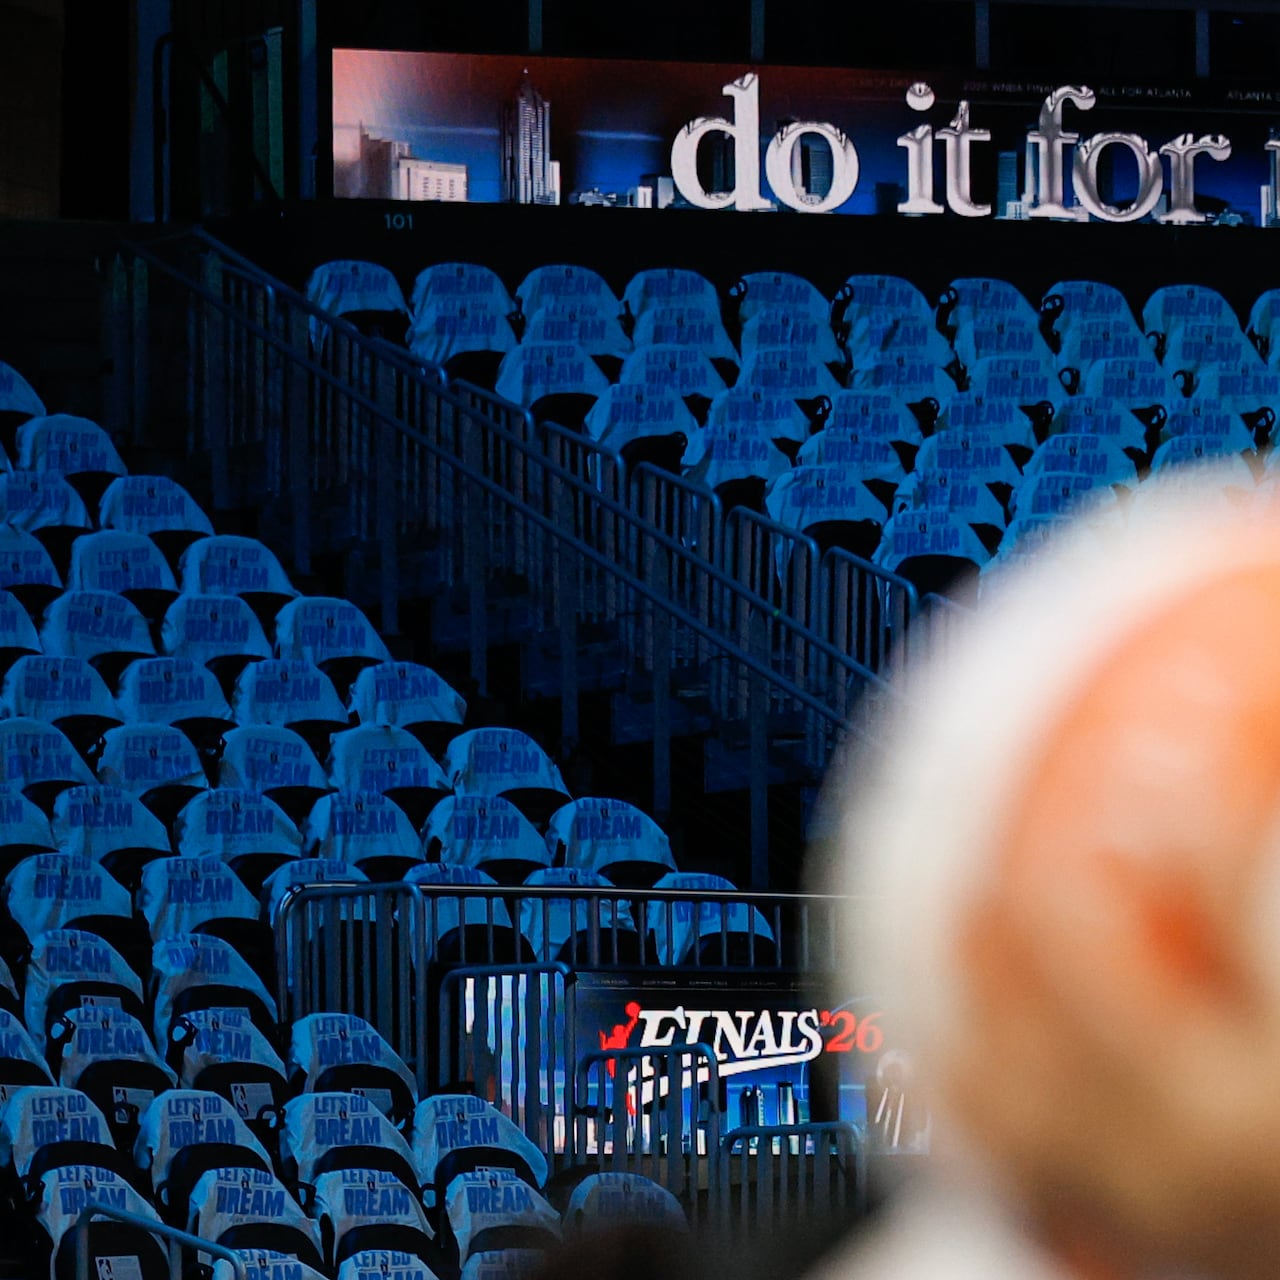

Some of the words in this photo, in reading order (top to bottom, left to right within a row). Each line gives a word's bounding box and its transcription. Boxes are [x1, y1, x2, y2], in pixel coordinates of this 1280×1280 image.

[671, 73, 859, 213] do
[897, 82, 991, 217] it
[1027, 84, 1231, 223] for
[384, 213, 413, 230] 101
[632, 1006, 823, 1078] FINALS
[315, 1116, 381, 1145] DREAM
[217, 1185, 286, 1217] DREAM
